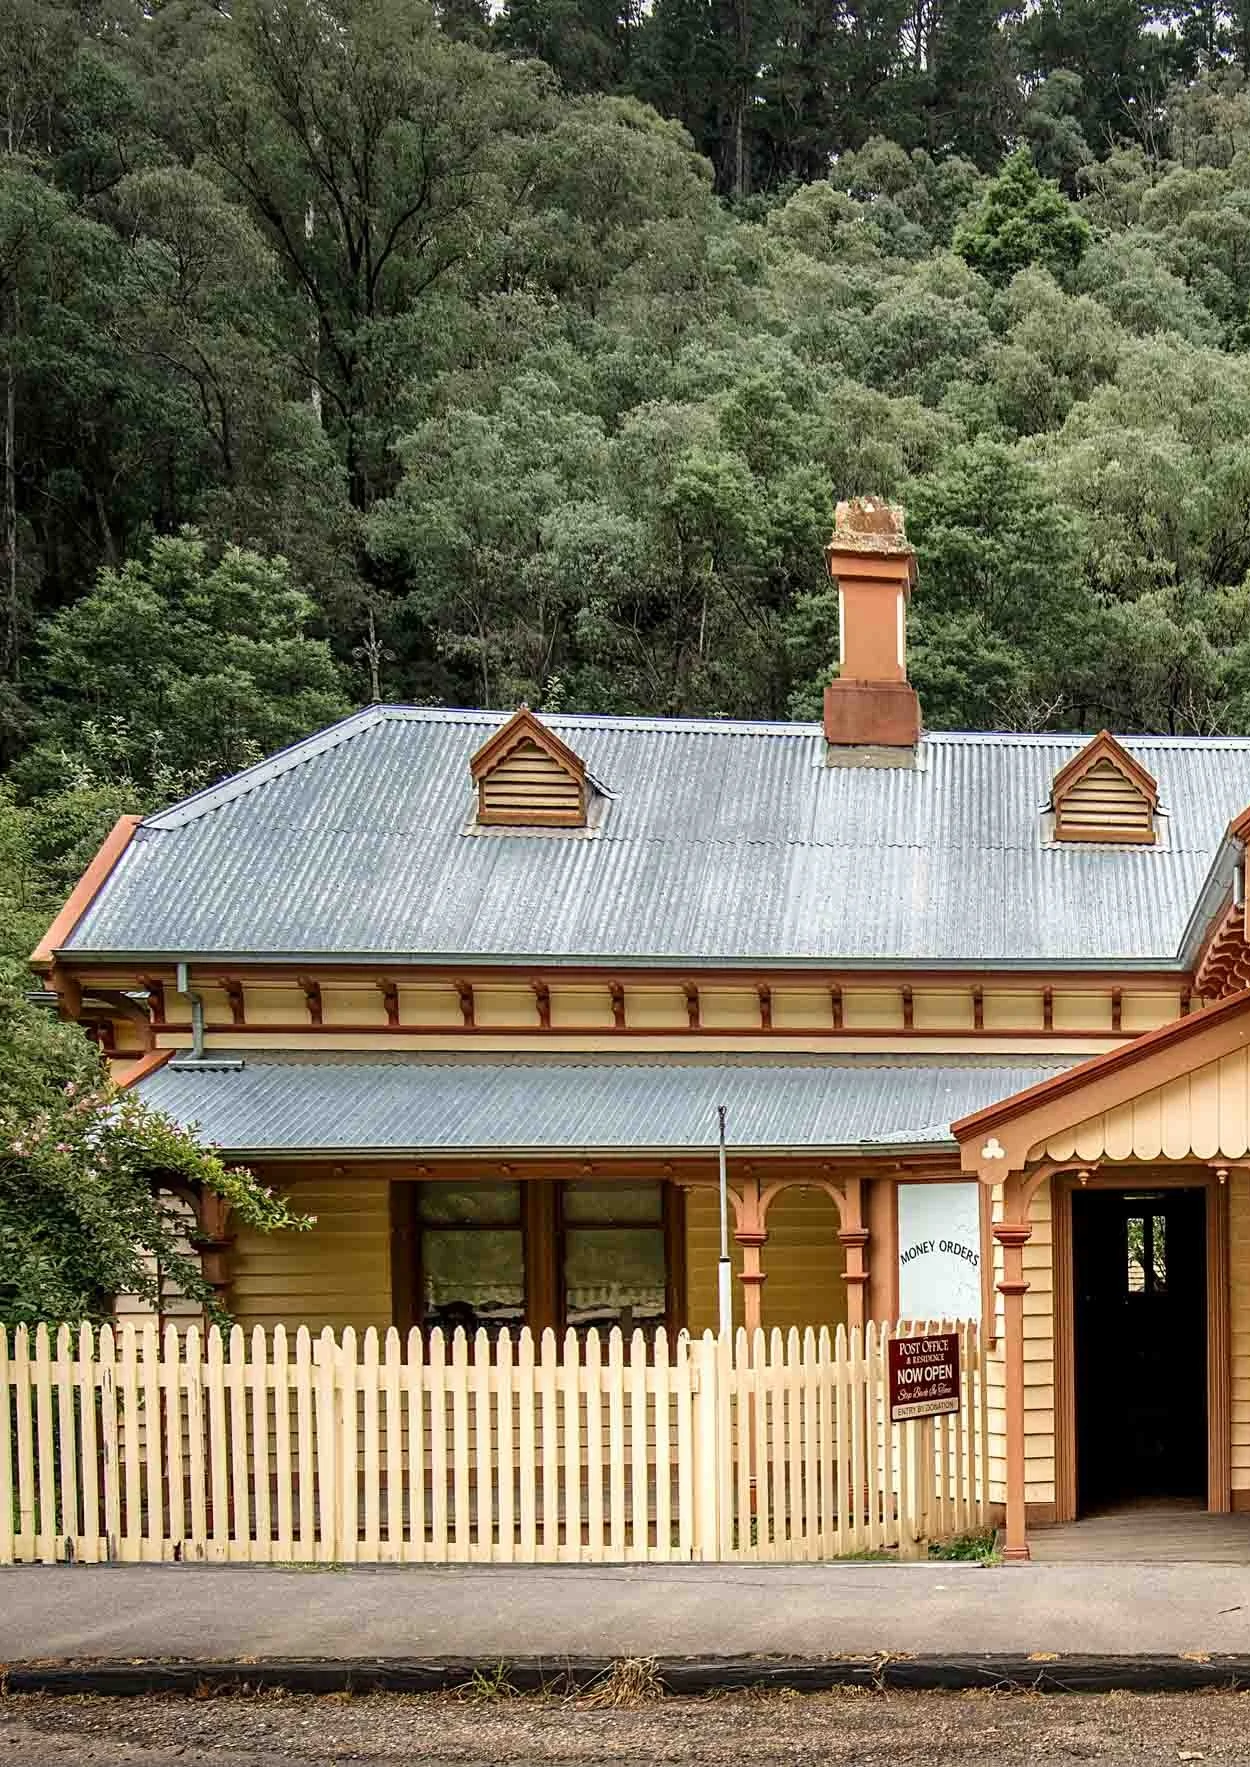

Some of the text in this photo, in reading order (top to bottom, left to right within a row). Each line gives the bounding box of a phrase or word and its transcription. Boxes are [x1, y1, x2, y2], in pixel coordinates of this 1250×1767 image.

[900, 1239, 980, 1266] MONEY ORDERS
[899, 1342, 921, 1356] POST
[906, 1353, 945, 1365] & RESIDENCE
[897, 1364, 953, 1385] NOW OPEN
[897, 1400, 953, 1416] ENTRY BY DONATION
